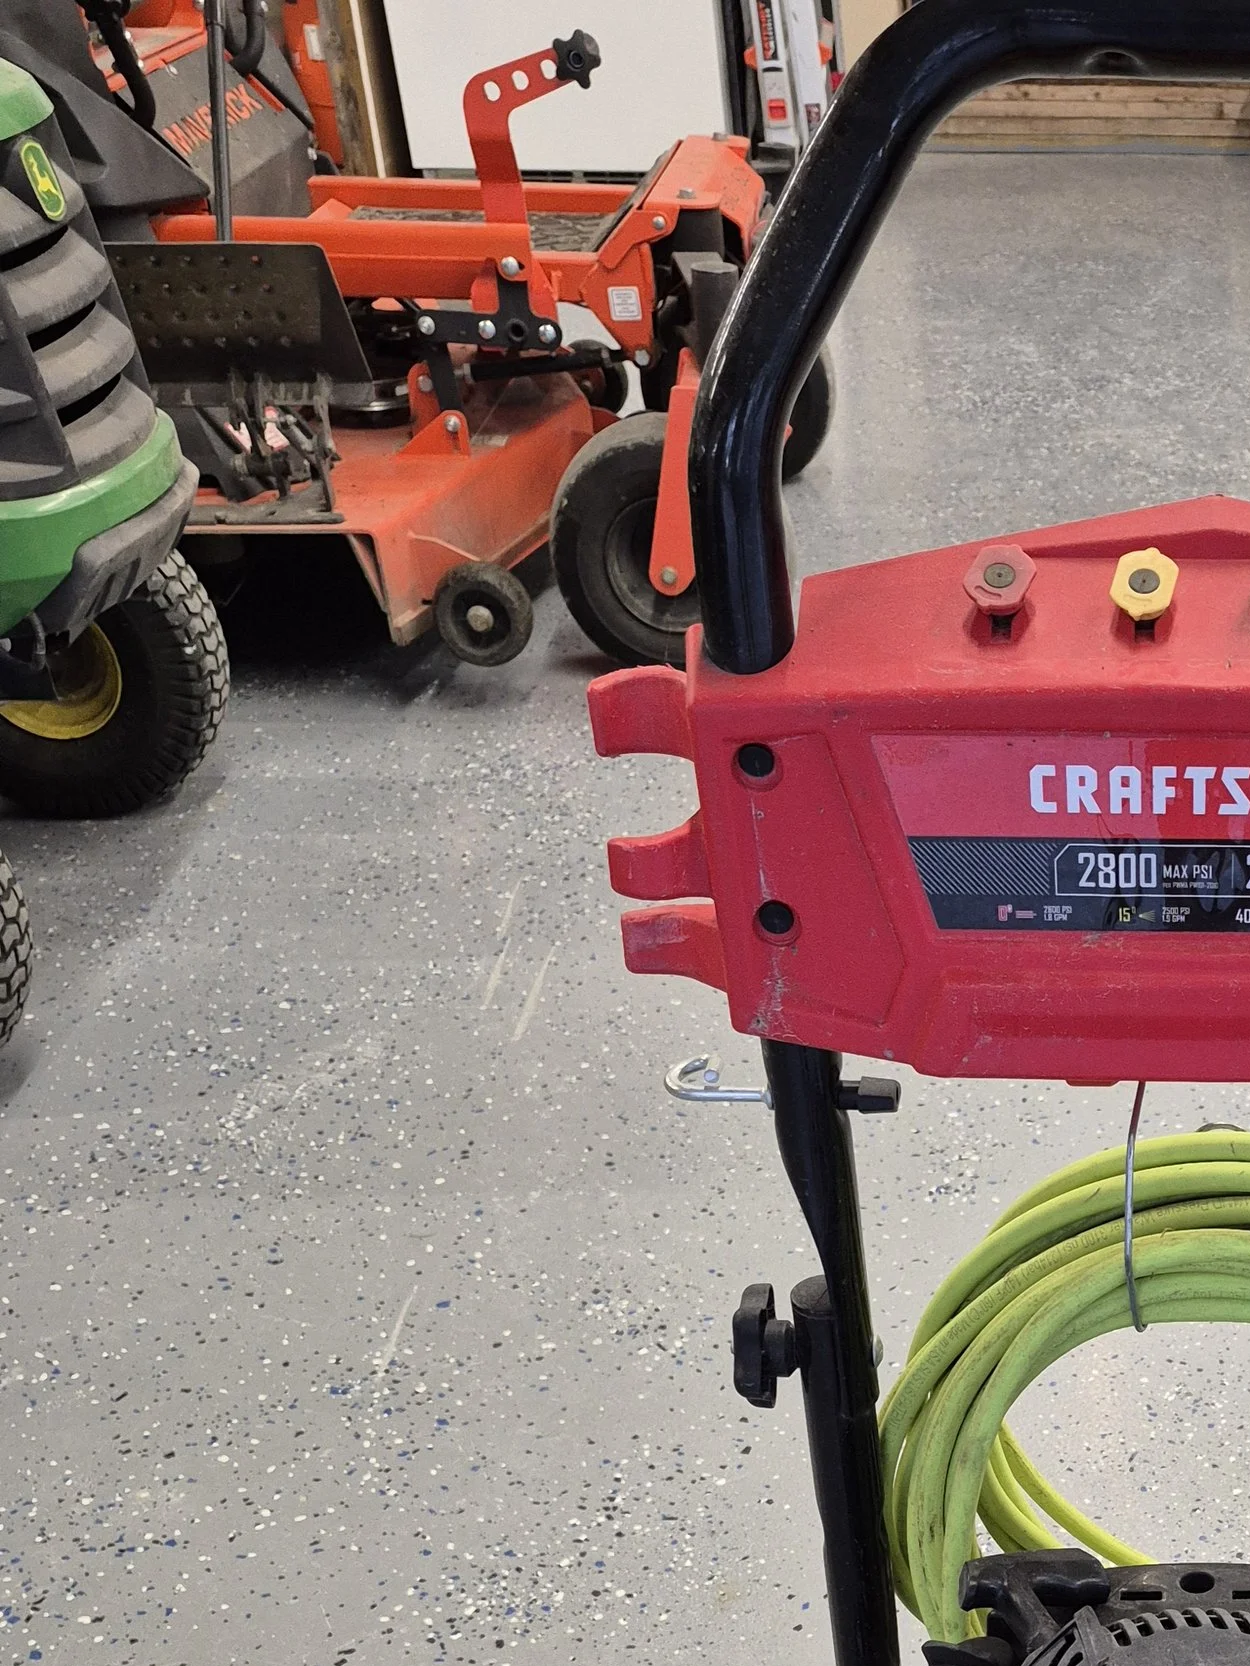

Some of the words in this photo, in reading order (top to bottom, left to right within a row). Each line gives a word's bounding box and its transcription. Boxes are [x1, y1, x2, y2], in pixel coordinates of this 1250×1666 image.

[1078, 852, 1157, 889] 2800
[1163, 865, 1188, 879] MAX
[1193, 865, 1213, 879] PSI
